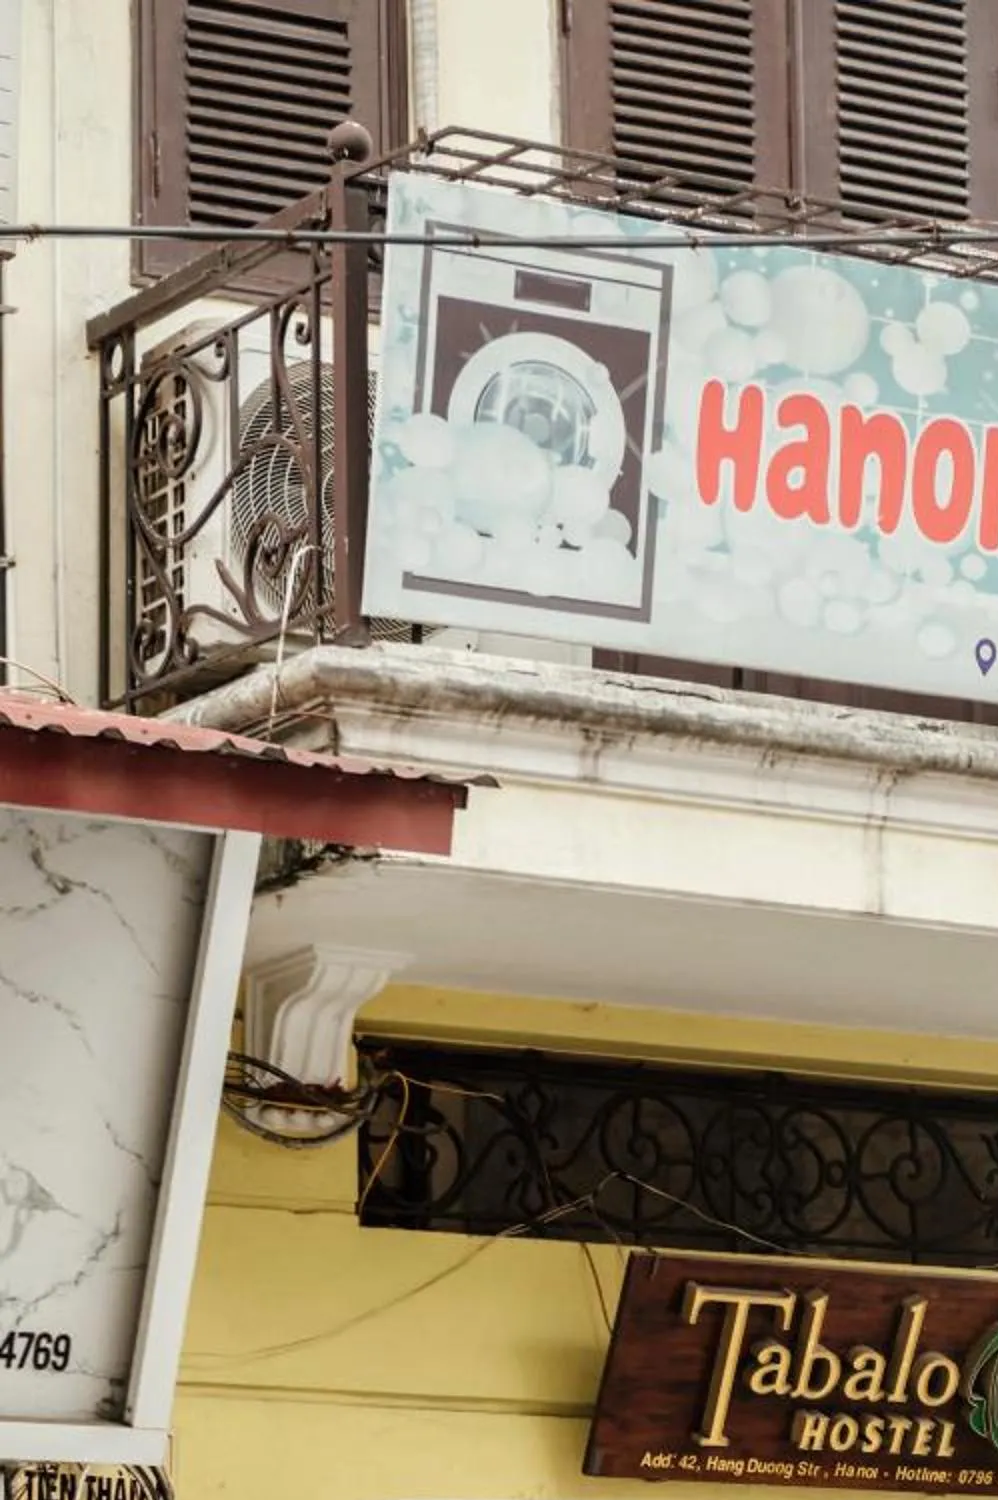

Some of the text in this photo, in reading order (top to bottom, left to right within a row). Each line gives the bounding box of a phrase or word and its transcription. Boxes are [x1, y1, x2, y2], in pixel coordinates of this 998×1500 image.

[0, 1330, 71, 1372] 4769
[684, 1279, 960, 1447] Tabalo
[798, 1411, 956, 1459] HOSTEL
[706, 1455, 744, 1477] Hang
[747, 1457, 793, 1478] Duong
